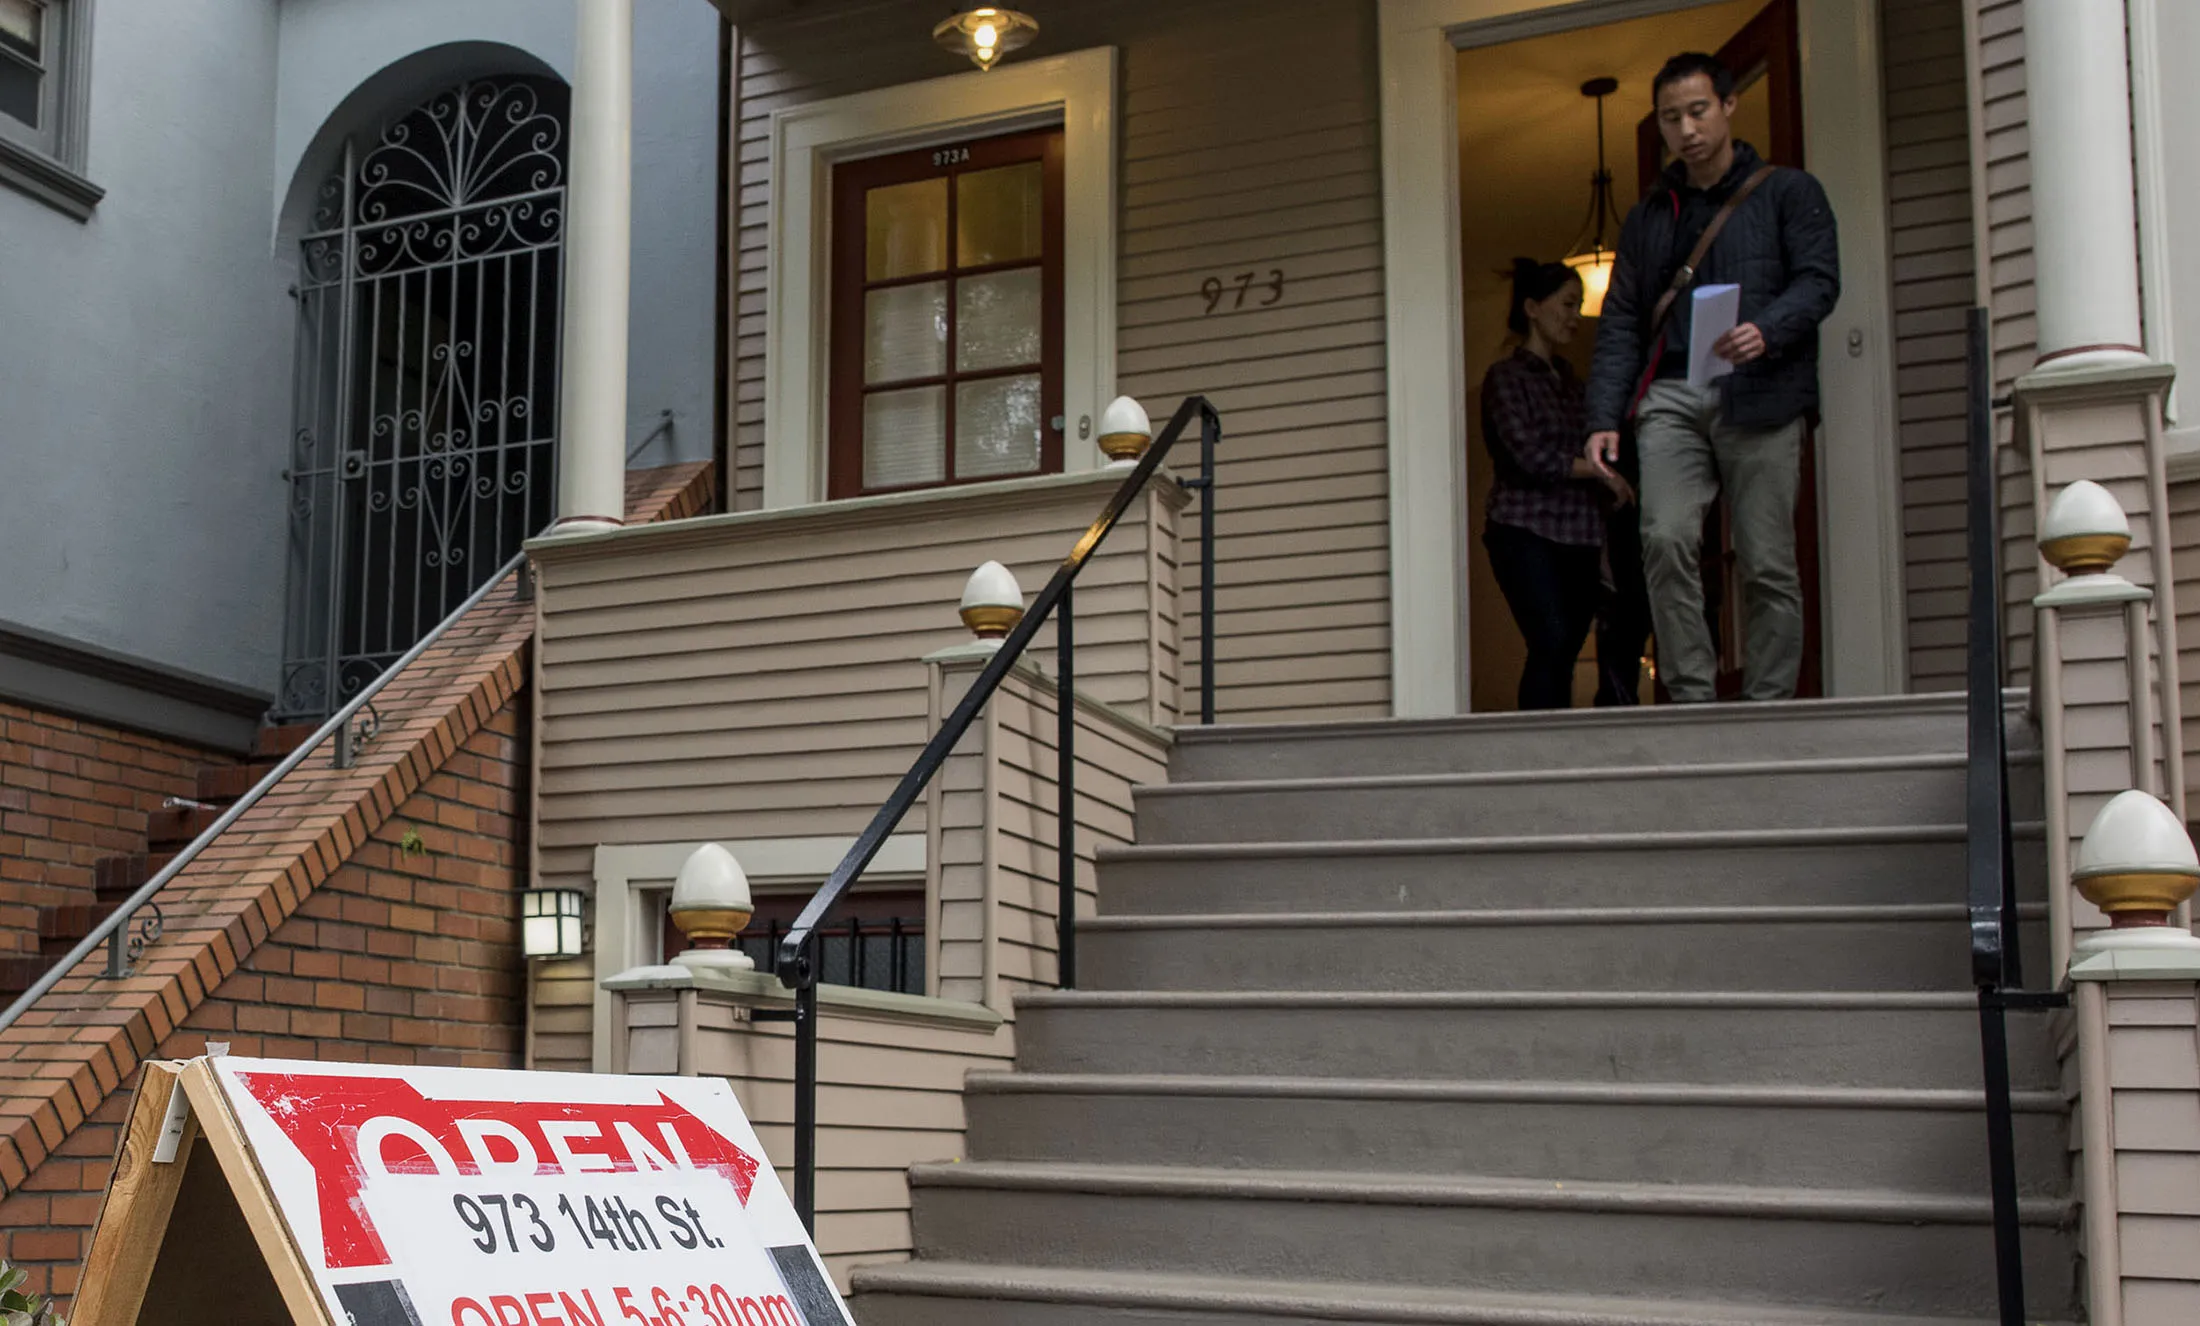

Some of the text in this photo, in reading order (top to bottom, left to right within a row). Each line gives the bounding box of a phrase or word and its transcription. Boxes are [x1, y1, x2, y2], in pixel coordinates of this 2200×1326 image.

[933, 147, 970, 167] 973A
[1201, 268, 1284, 314] 973
[453, 1192, 726, 1254] 973 14th St.
